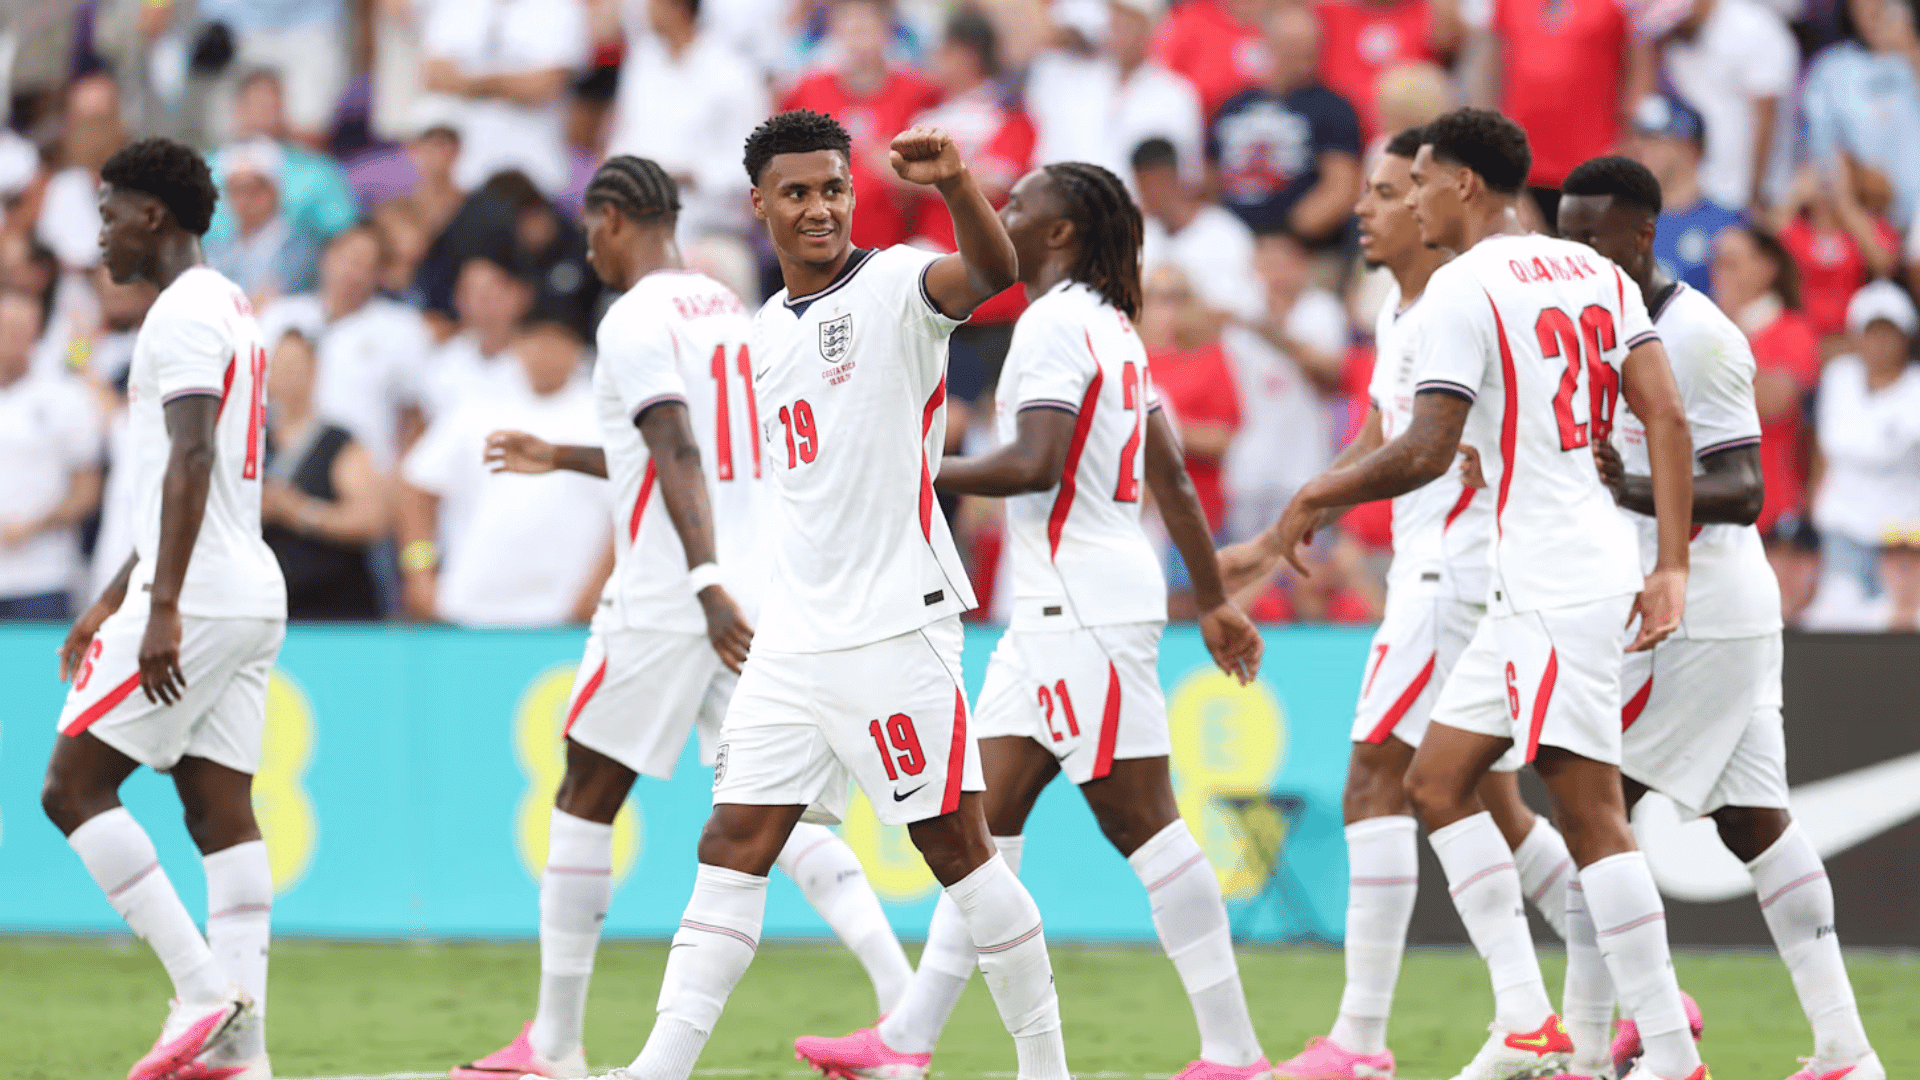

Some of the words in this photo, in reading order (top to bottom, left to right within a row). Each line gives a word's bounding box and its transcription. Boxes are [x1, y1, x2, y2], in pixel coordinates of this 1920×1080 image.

[710, 342, 763, 480] 11
[1534, 303, 1619, 451] 26
[778, 398, 819, 469] 19
[868, 711, 926, 781] 19
[1037, 678, 1081, 743] 21
